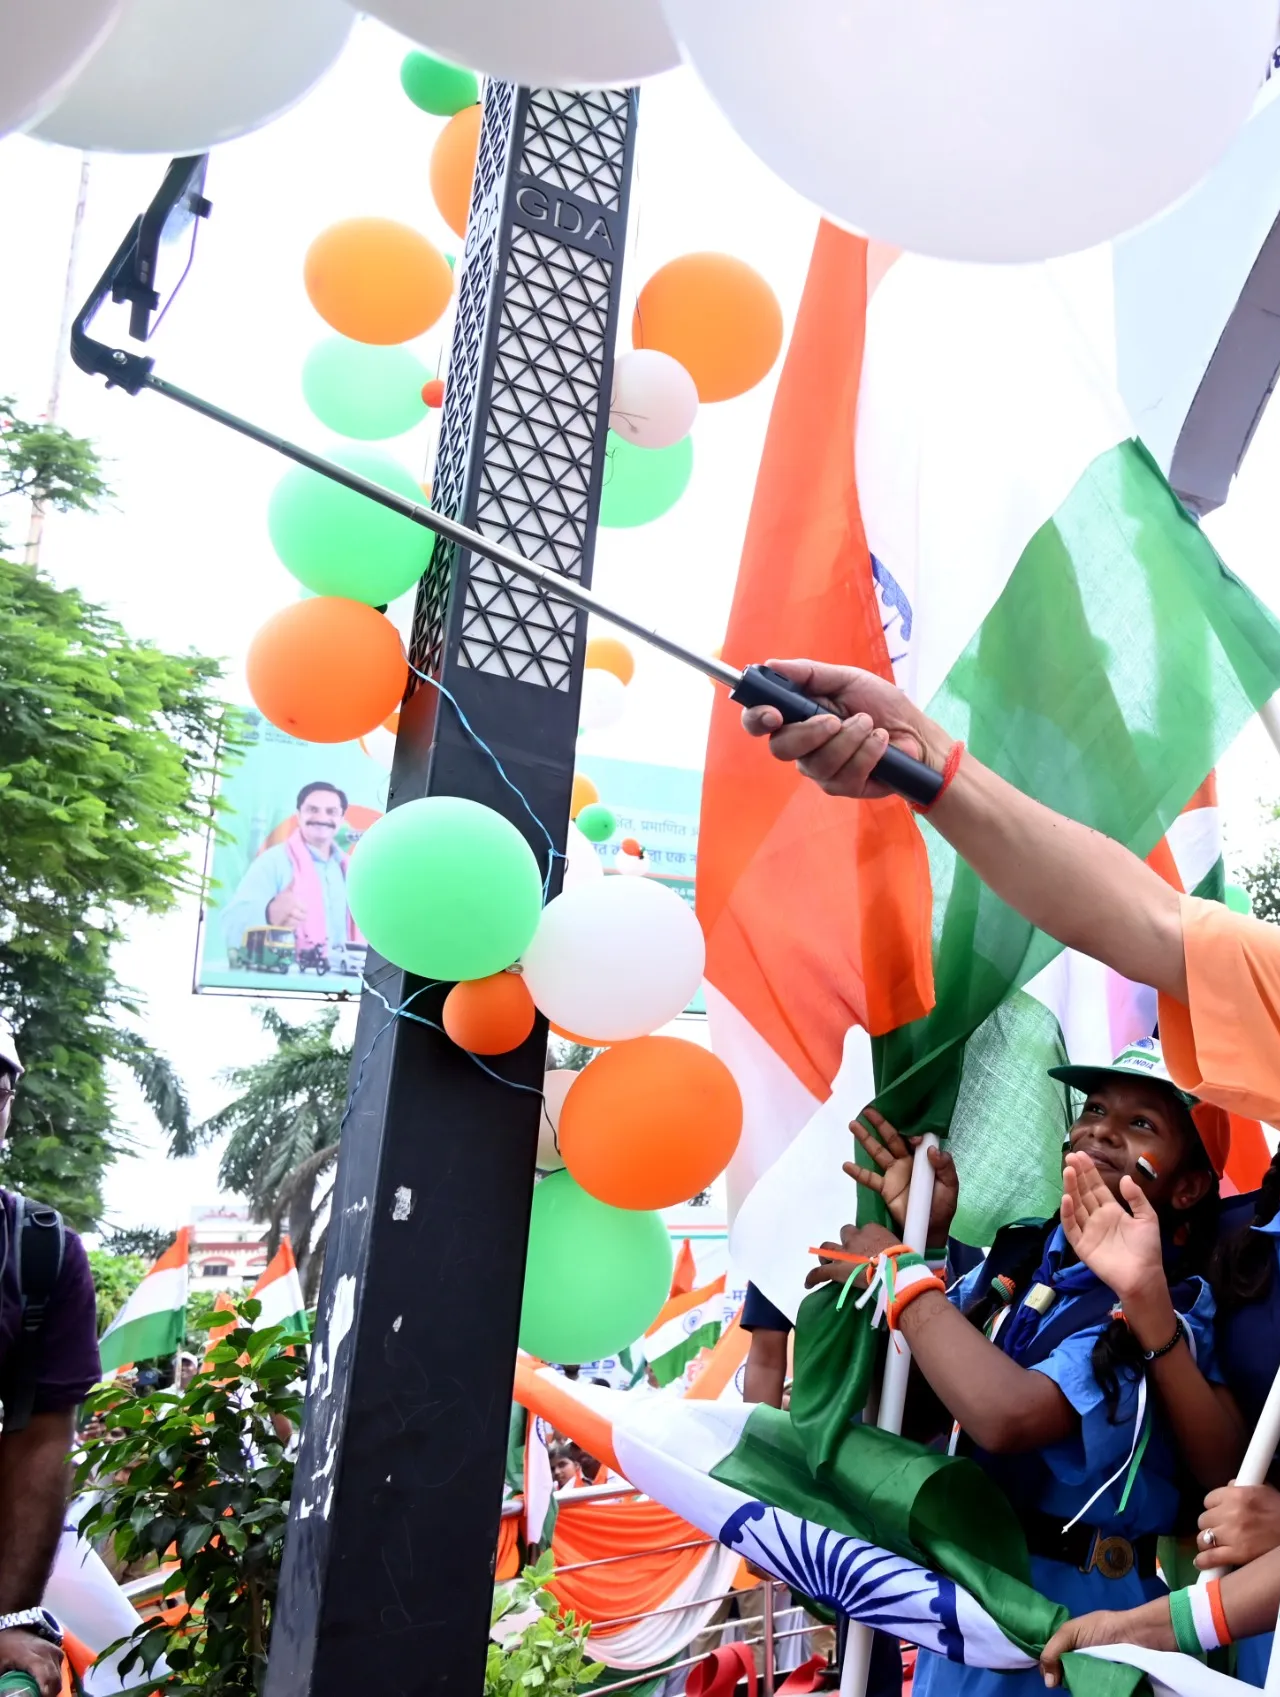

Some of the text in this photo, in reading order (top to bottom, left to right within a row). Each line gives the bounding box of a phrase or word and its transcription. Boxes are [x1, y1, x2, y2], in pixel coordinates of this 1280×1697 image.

[464, 192, 499, 259] GDA
[515, 185, 615, 251] GDA
[1132, 1058, 1155, 1071] INDIA
